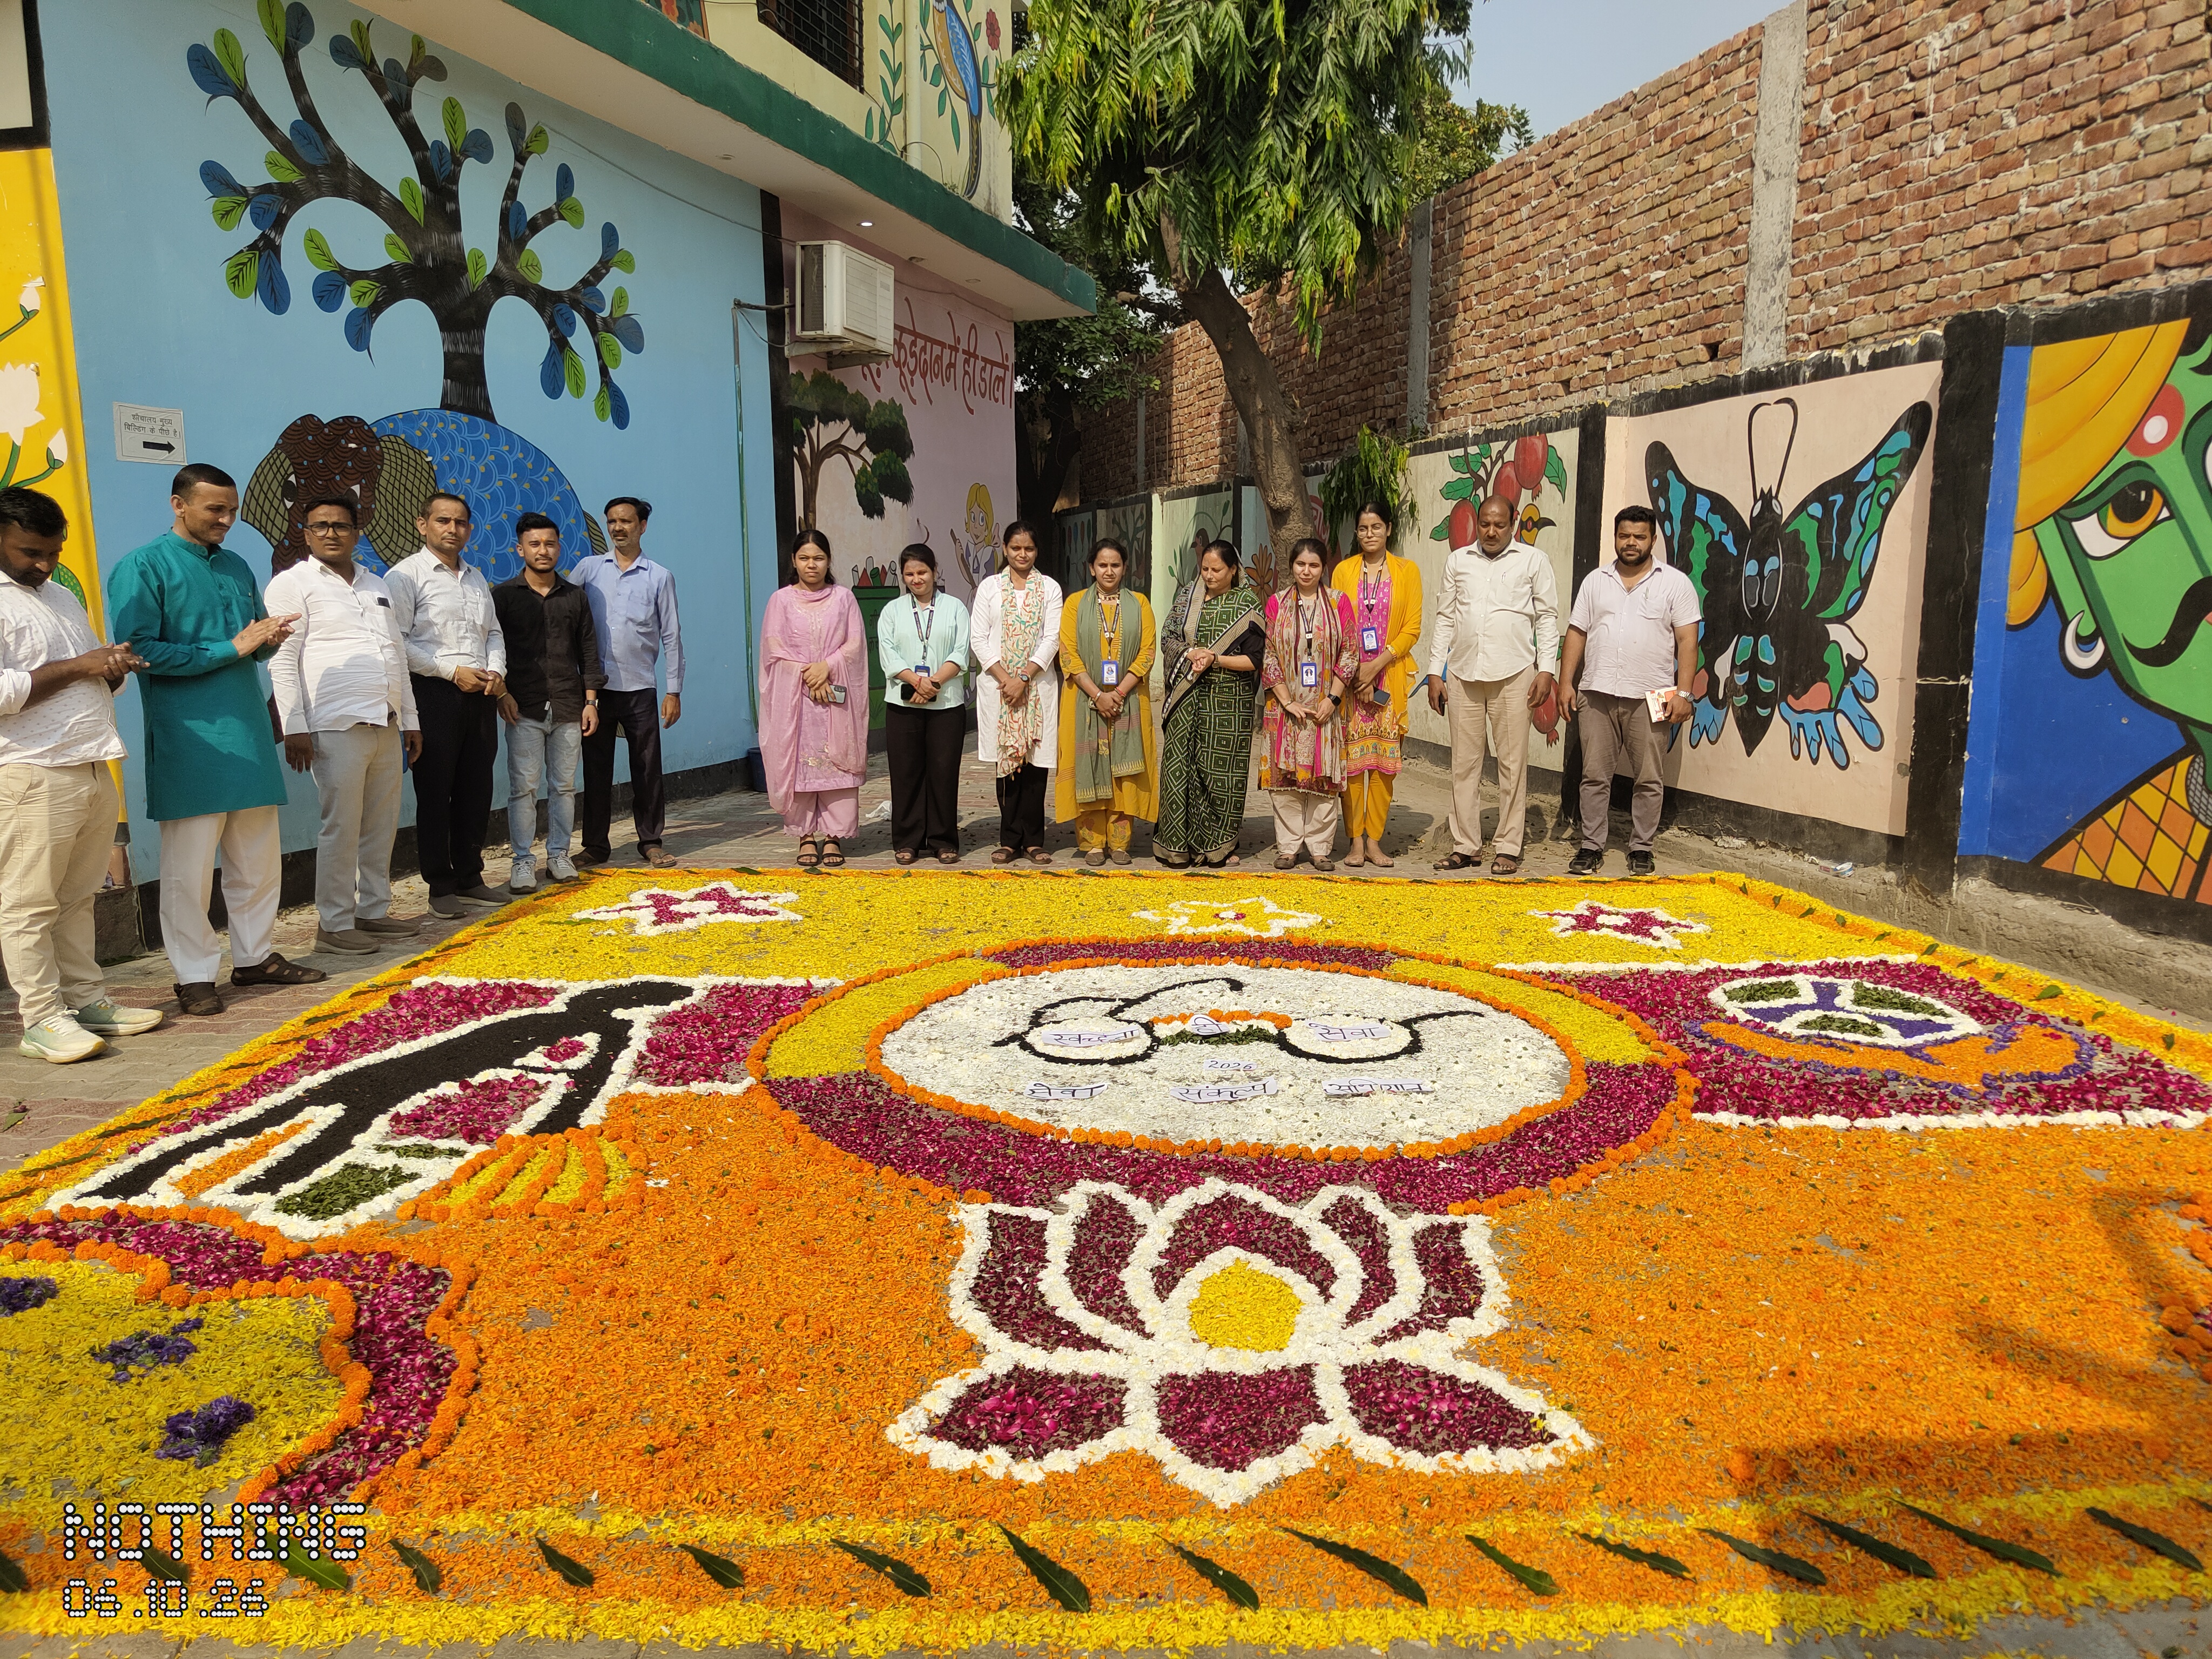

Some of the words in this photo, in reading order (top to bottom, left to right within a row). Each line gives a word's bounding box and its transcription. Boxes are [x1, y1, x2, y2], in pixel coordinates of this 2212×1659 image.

[945, 311, 961, 391] में
[962, 323, 979, 415] ही
[159, 417, 172, 427] मुख्य
[149, 426, 156, 434] के
[158, 427, 170, 436] पीछे
[1191, 1017, 1223, 1034] ही
[1309, 1023, 1379, 1041] सेवा
[1208, 1060, 1254, 1070] 2026
[1027, 1083, 1105, 1098] सेवा
[1178, 1081, 1270, 1100] संकल्प
